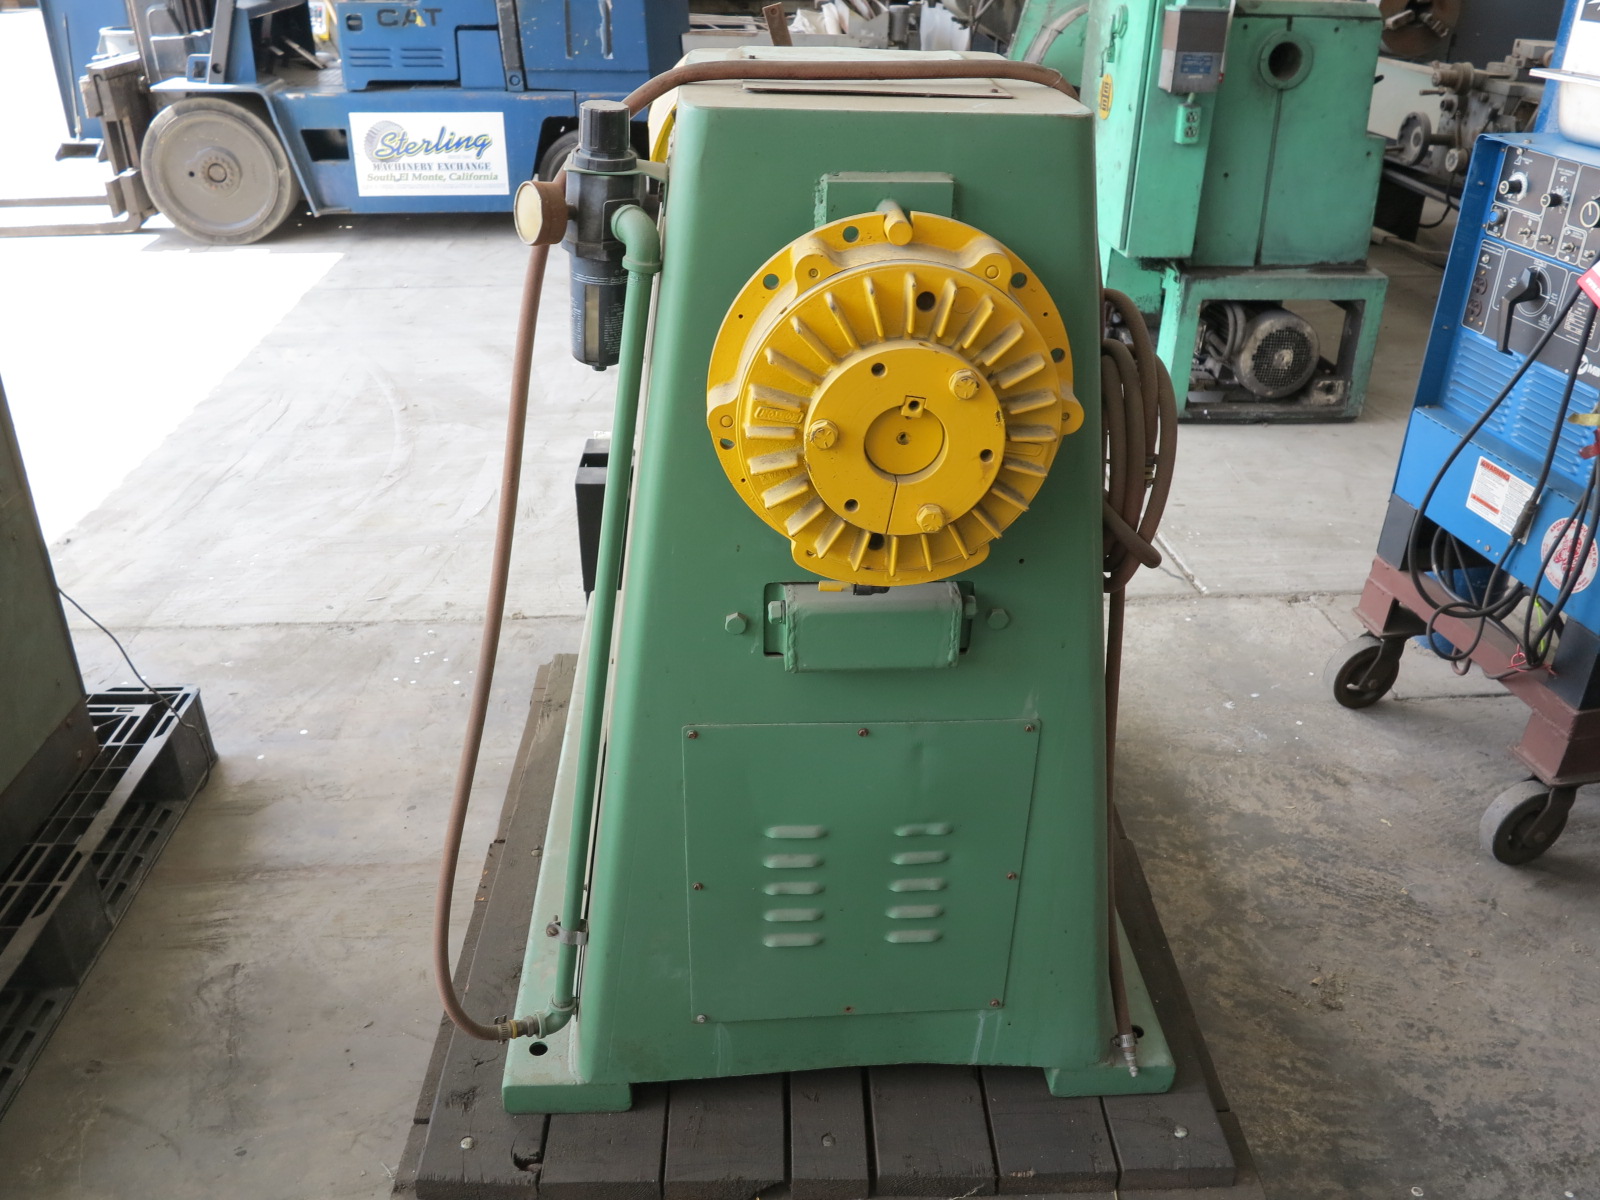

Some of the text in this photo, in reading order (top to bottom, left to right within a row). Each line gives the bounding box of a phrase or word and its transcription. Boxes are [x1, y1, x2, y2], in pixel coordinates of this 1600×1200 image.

[376, 8, 443, 27] CAT
[374, 125, 493, 160] Sterling
[372, 161, 492, 171] MACHINERY EXCHANGE
[366, 171, 499, 183] South El Monte, California
